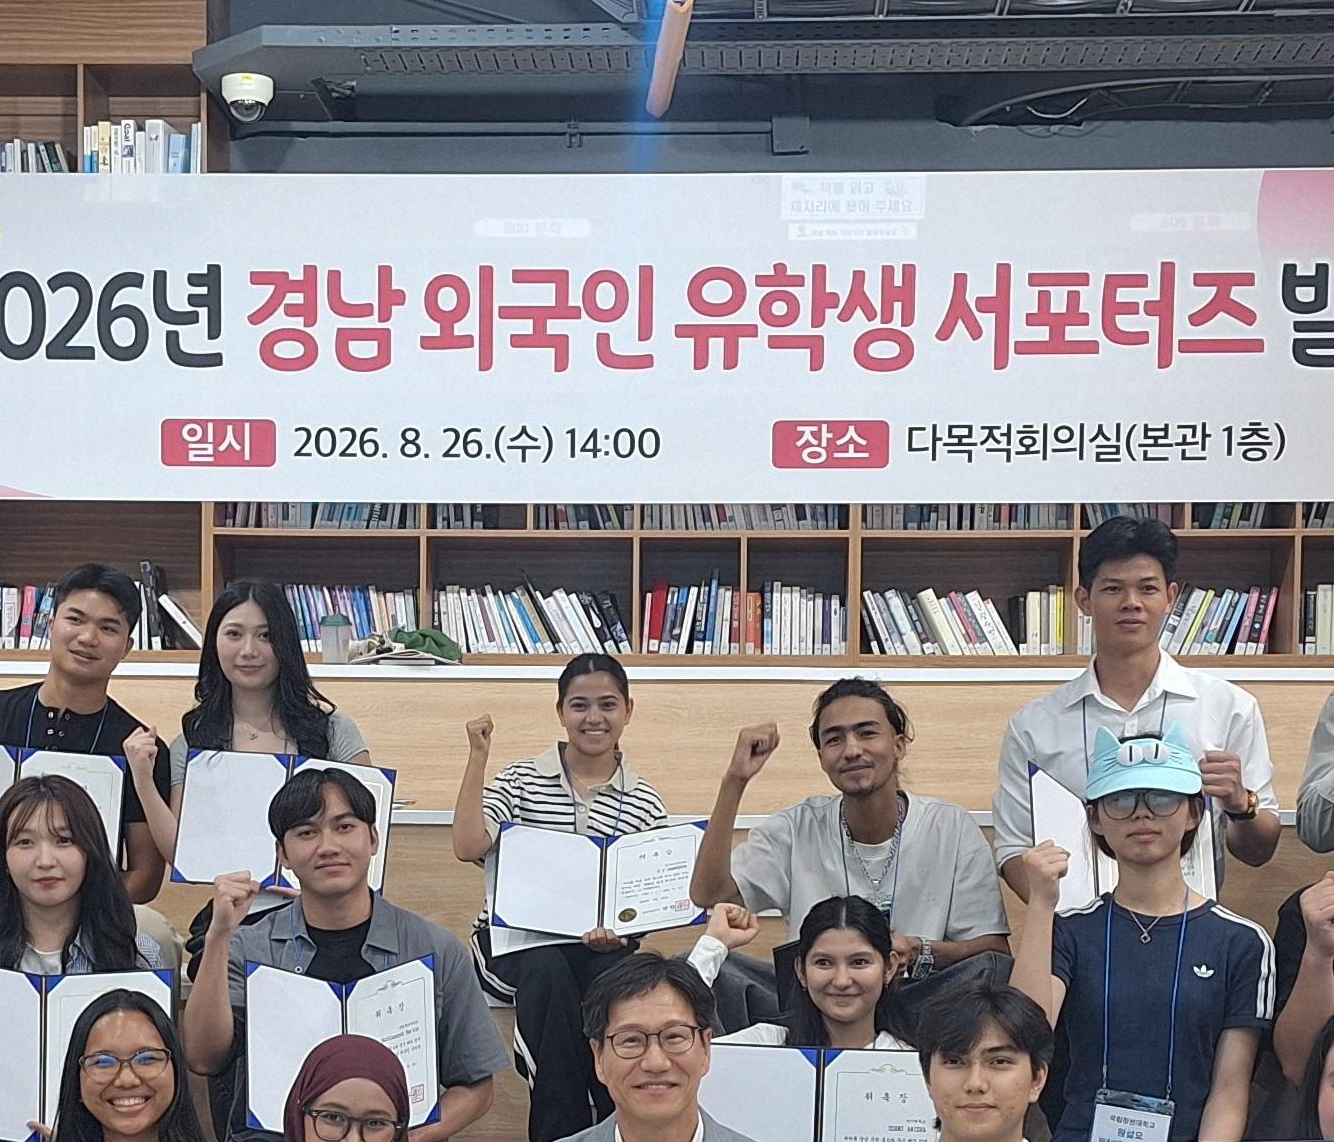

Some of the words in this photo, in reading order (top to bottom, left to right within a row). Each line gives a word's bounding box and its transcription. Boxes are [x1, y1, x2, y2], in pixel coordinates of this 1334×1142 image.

[247, 264, 406, 372] 경남
[419, 264, 656, 371] 외국인
[674, 263, 917, 373] 유학생
[935, 261, 1265, 371] 서포터즈
[180, 424, 252, 462] 일시
[293, 426, 389, 460] 2026.
[399, 426, 430, 460] 8.
[442, 425, 554, 464] 26.(수)
[565, 427, 661, 460] 14:00
[794, 425, 870, 461] 장소
[906, 421, 1211, 464] 다목적회의실(본관
[1222, 420, 1287, 463] 1층)
